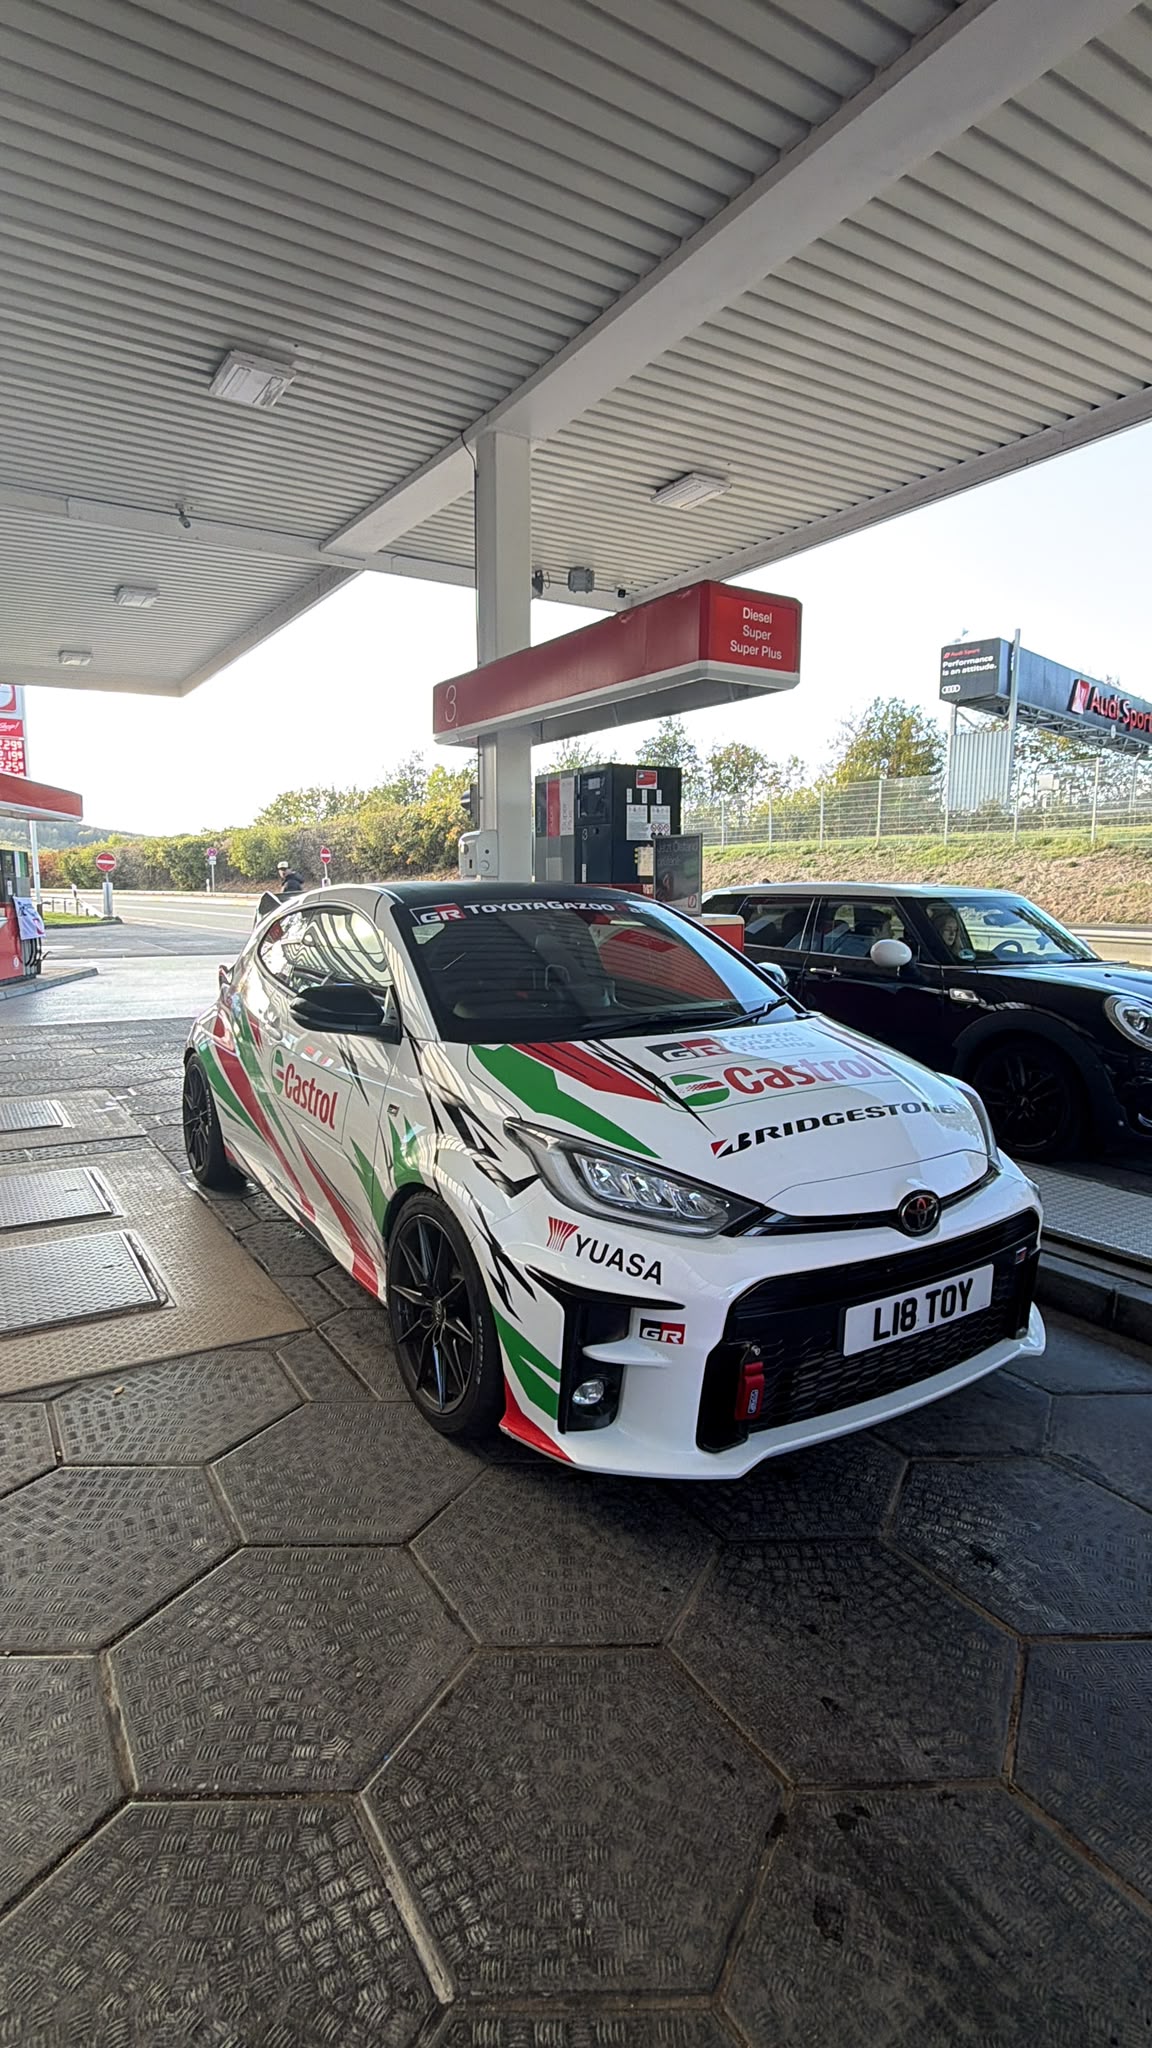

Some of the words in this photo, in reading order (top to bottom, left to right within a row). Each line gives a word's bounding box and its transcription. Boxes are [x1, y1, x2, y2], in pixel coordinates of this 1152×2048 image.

[742, 606, 773, 624] Diesel
[742, 624, 772, 641] Super
[730, 639, 760, 656] Super
[761, 645, 783, 660] Plus
[942, 655, 994, 669] Performance
[950, 668, 961, 676] an
[962, 662, 997, 674] attitude.
[444, 684, 457, 723] 3
[1089, 686, 1120, 720] Audi
[581, 828, 589, 841] 3
[420, 909, 462, 924] GR
[660, 1044, 730, 1062] GR
[723, 1053, 892, 1095] Castrol
[284, 1062, 339, 1131] Castrol
[711, 1101, 956, 1159] BRIDGESTONE
[575, 1233, 662, 1286] YUASA
[873, 1296, 918, 1342] L18
[925, 1277, 973, 1324] TOY
[641, 1326, 684, 1344] GR
